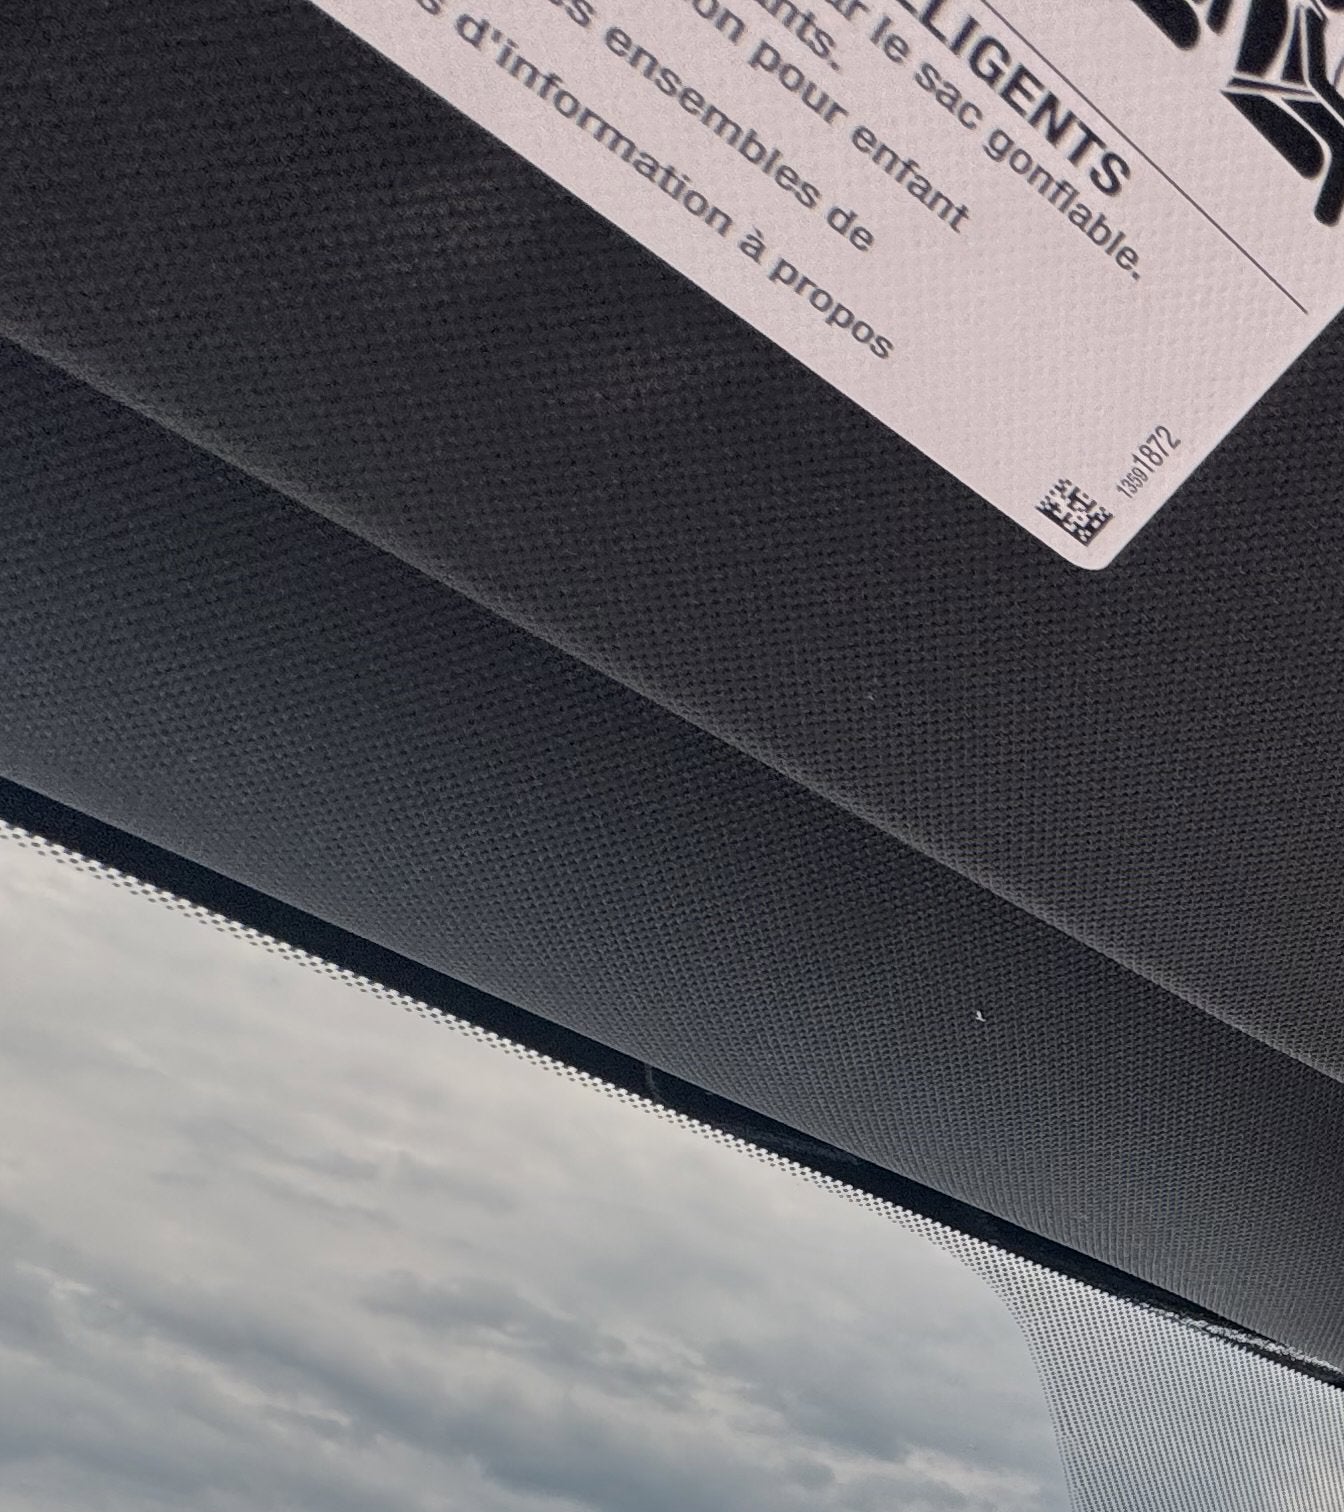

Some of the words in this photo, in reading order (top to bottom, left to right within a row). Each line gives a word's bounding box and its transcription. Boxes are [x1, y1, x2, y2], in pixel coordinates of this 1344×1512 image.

[455, 13, 734, 239] d'information
[737, 224, 767, 265] à
[768, 257, 895, 360] propos
[604, 26, 822, 210] ensembles
[826, 205, 875, 252] de
[747, 39, 850, 126] pour
[851, 125, 971, 234] enfant
[869, 15, 910, 64] le
[914, 62, 984, 131] sac
[983, 129, 1141, 282] gonflable.
[1115, 425, 1182, 499] 13591872
